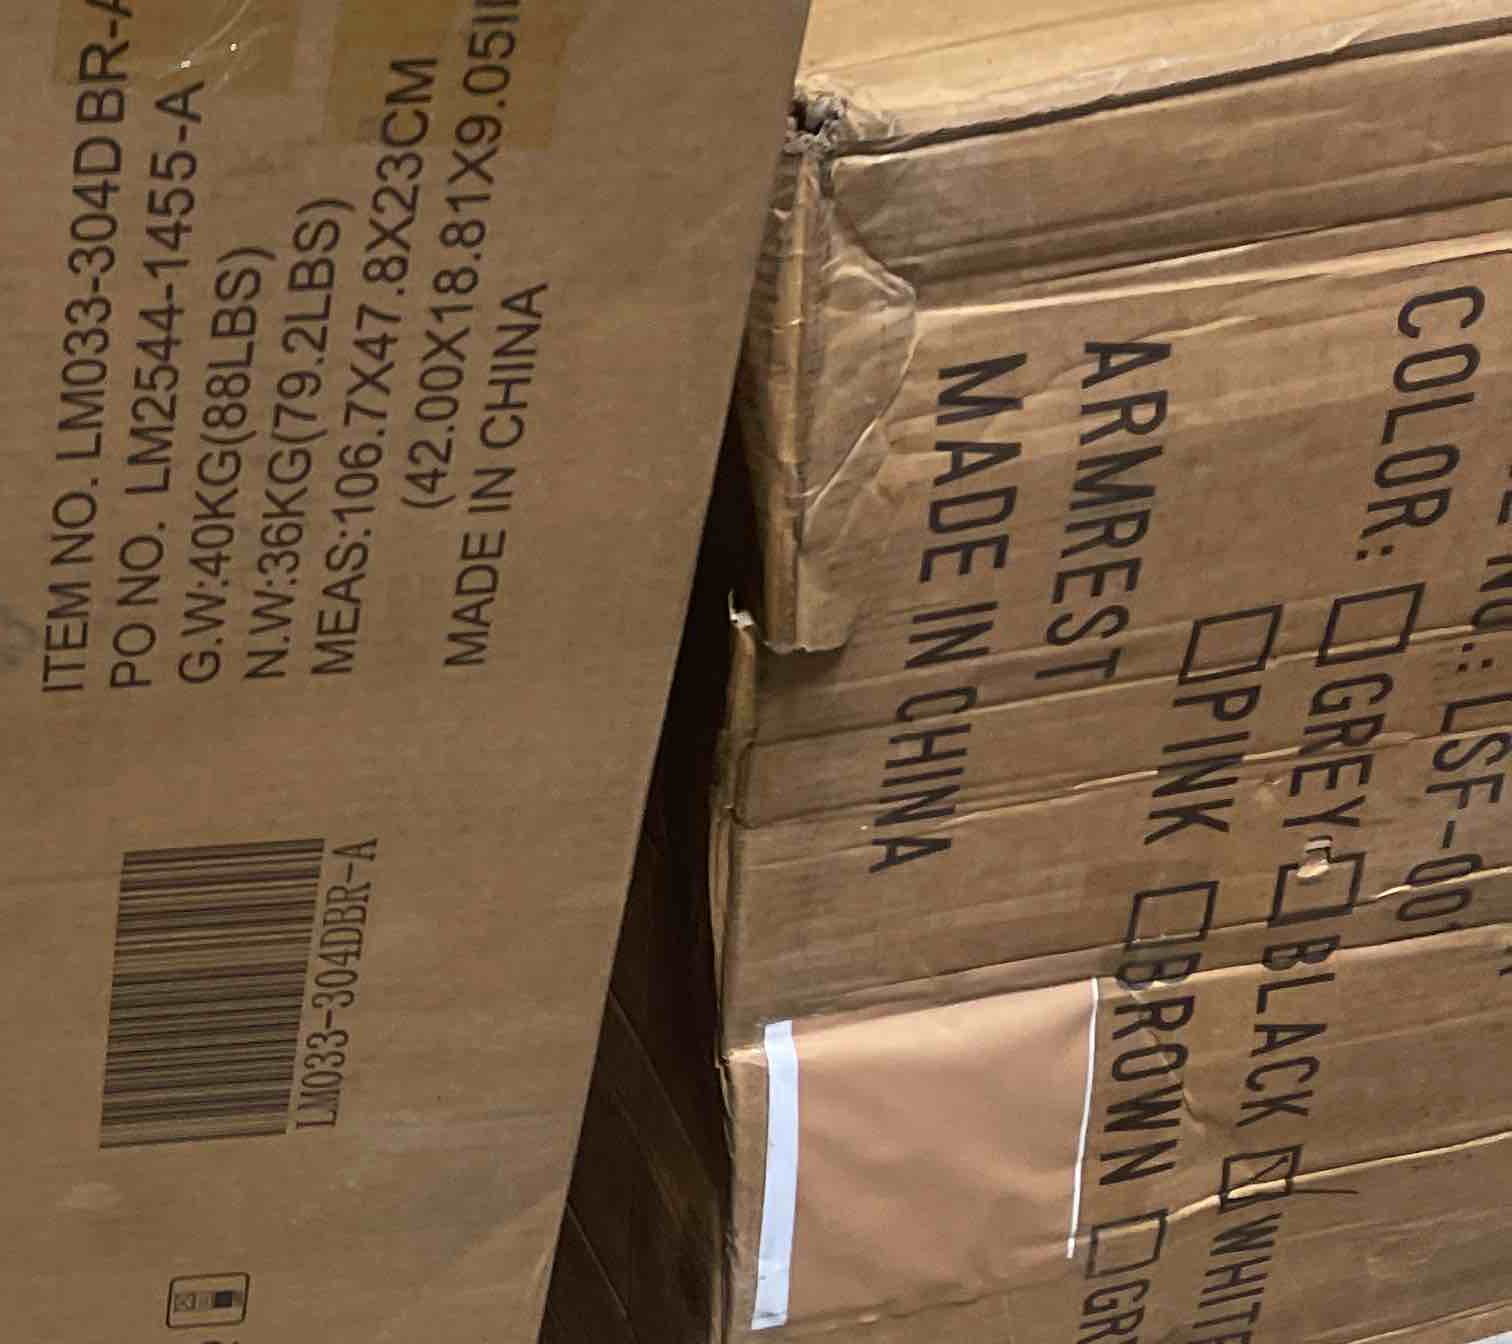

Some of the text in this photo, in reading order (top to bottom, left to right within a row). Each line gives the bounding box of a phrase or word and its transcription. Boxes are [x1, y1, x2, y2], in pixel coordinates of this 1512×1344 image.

[110, 80, 205, 690] PO NO. LM2544-1455-A
[443, 280, 549, 669] MADE IN CHINA
[1355, 284, 1486, 561] COLOR:
[51, 478, 99, 575] NO.
[869, 353, 1027, 873] MADE IN CHINA
[1035, 341, 1172, 680] ARMREST
[42, 582, 90, 694] ITEM
[1284, 672, 1394, 828] GREY
[1144, 685, 1260, 846] PINK
[1100, 950, 1202, 1187] BROWN
[1238, 935, 1341, 1128] BLACK
